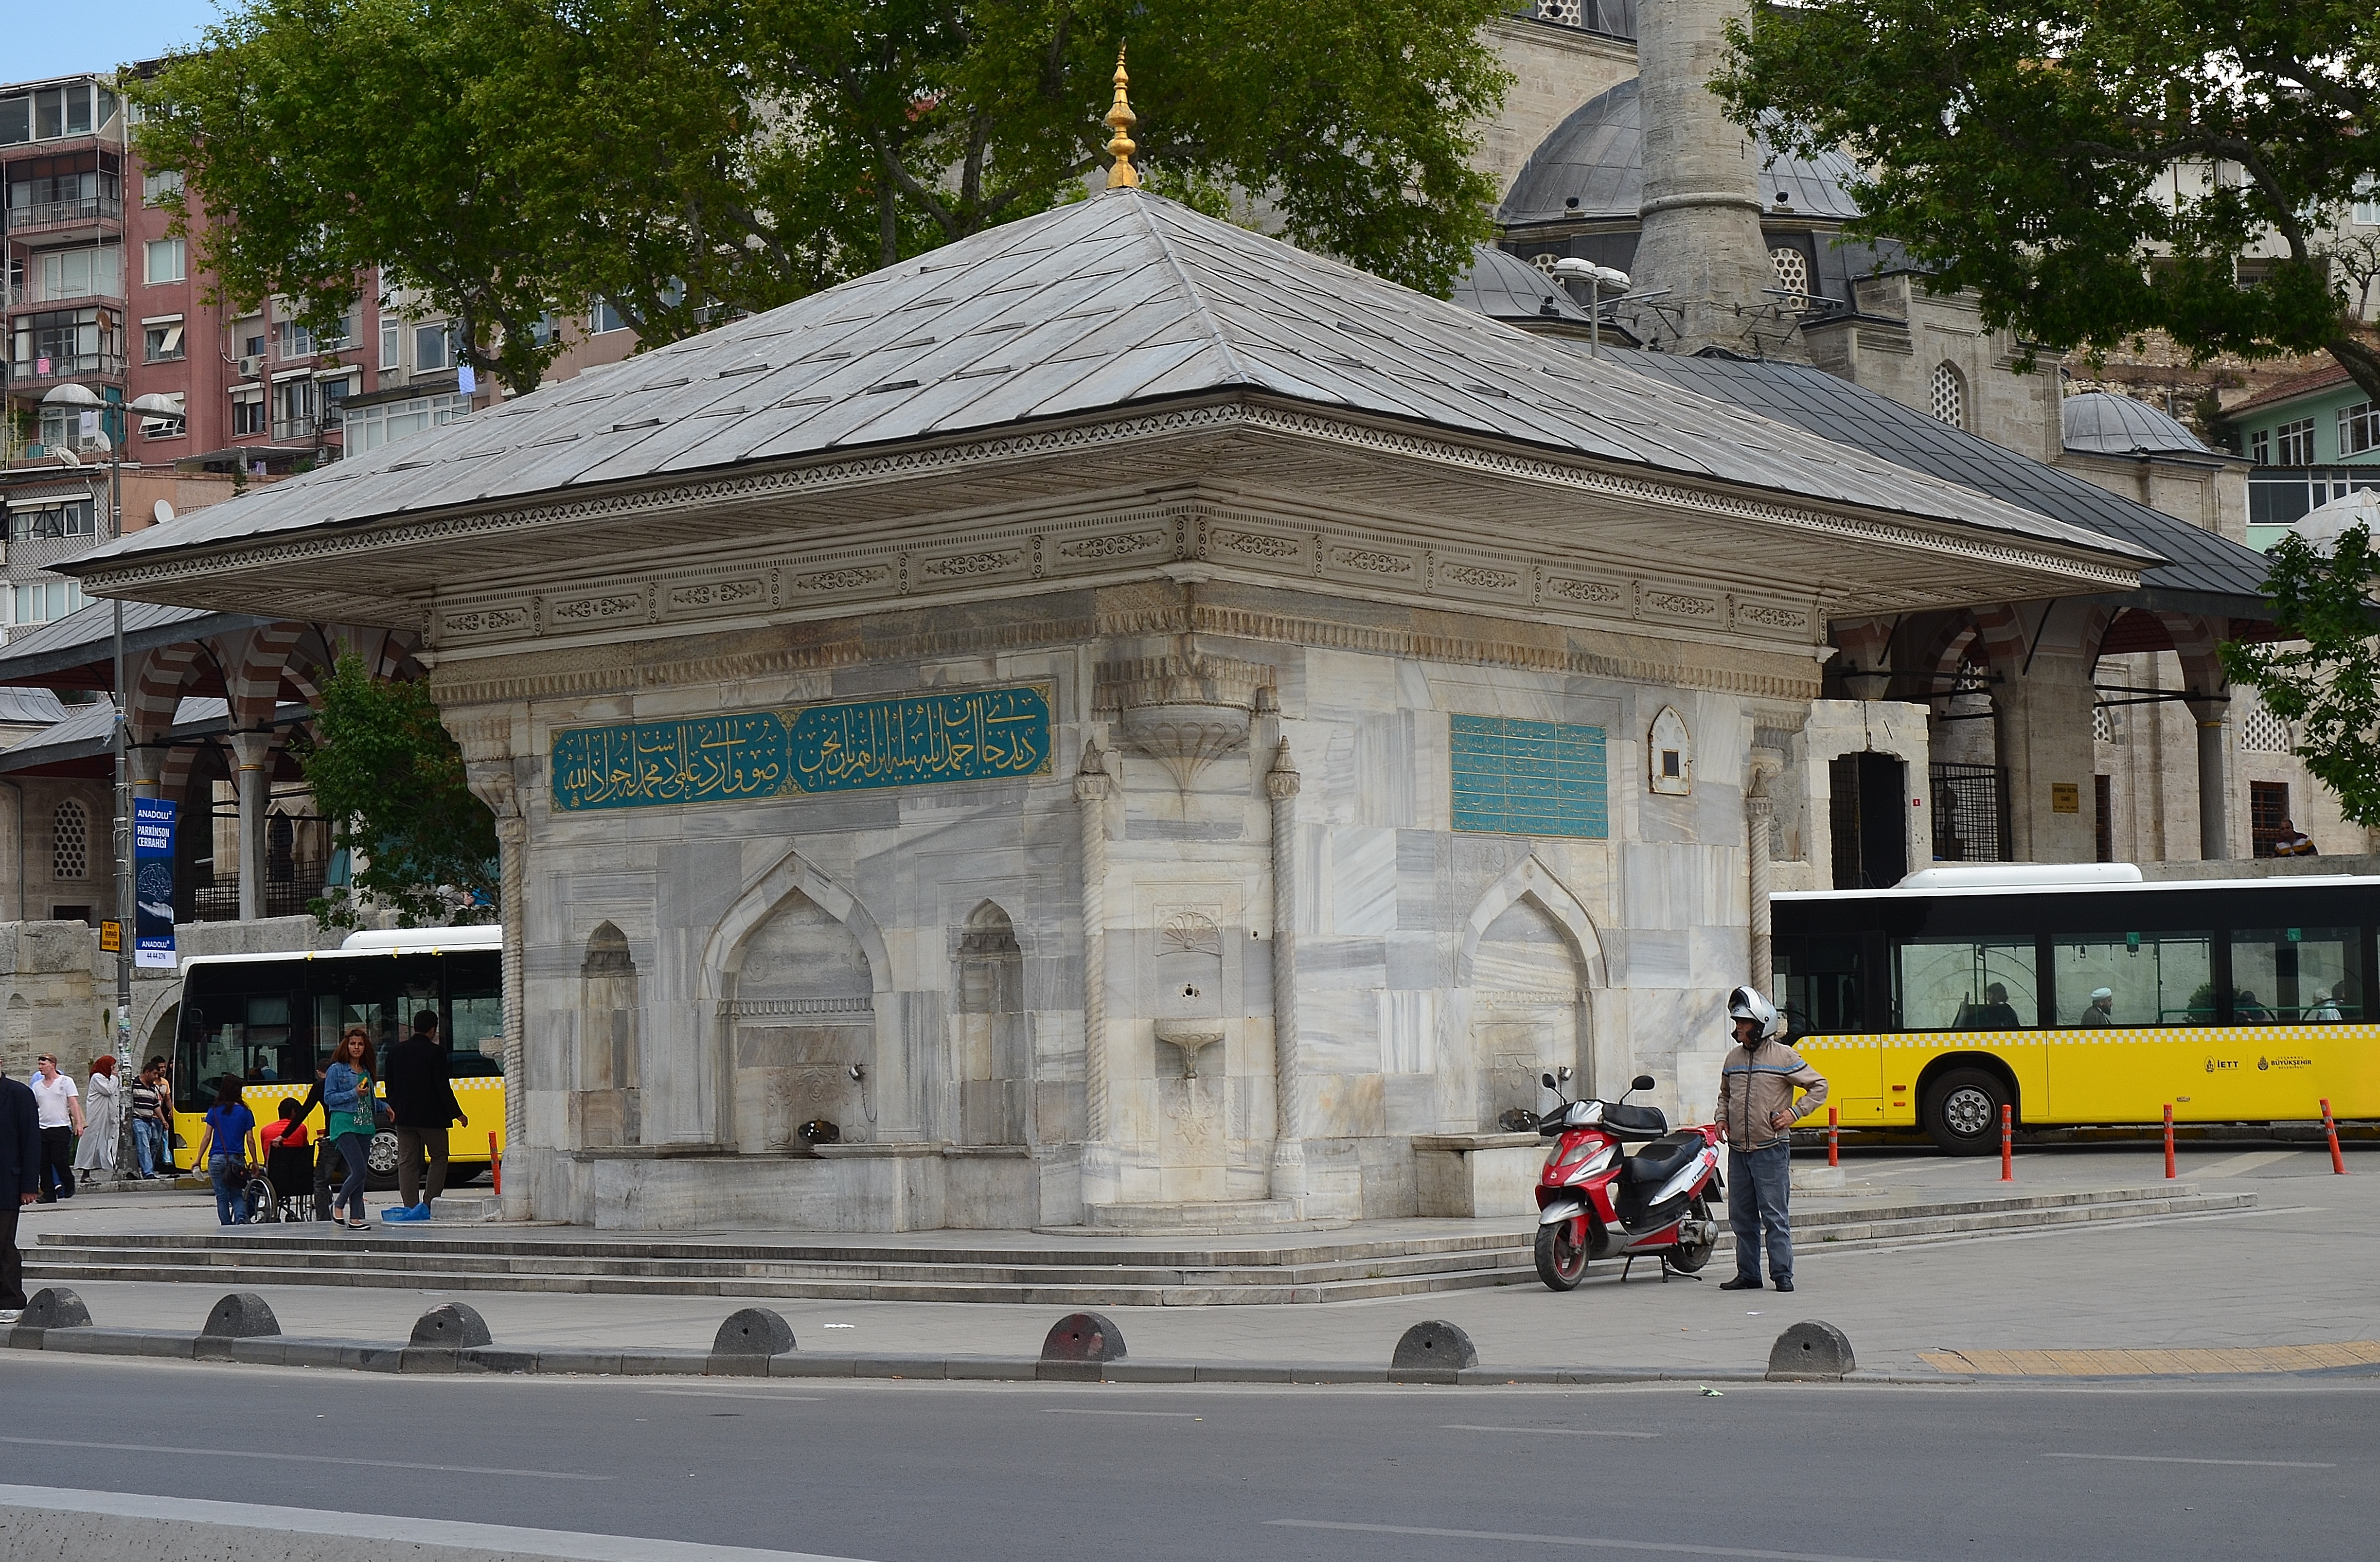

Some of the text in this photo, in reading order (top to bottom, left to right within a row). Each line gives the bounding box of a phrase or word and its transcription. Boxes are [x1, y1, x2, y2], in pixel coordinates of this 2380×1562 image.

[138, 809, 169, 820] ANADOLU
[137, 825, 170, 837] PARKİNSON
[137, 837, 167, 849] CERRAHİSİ
[2217, 1060, 2238, 1068] İETT
